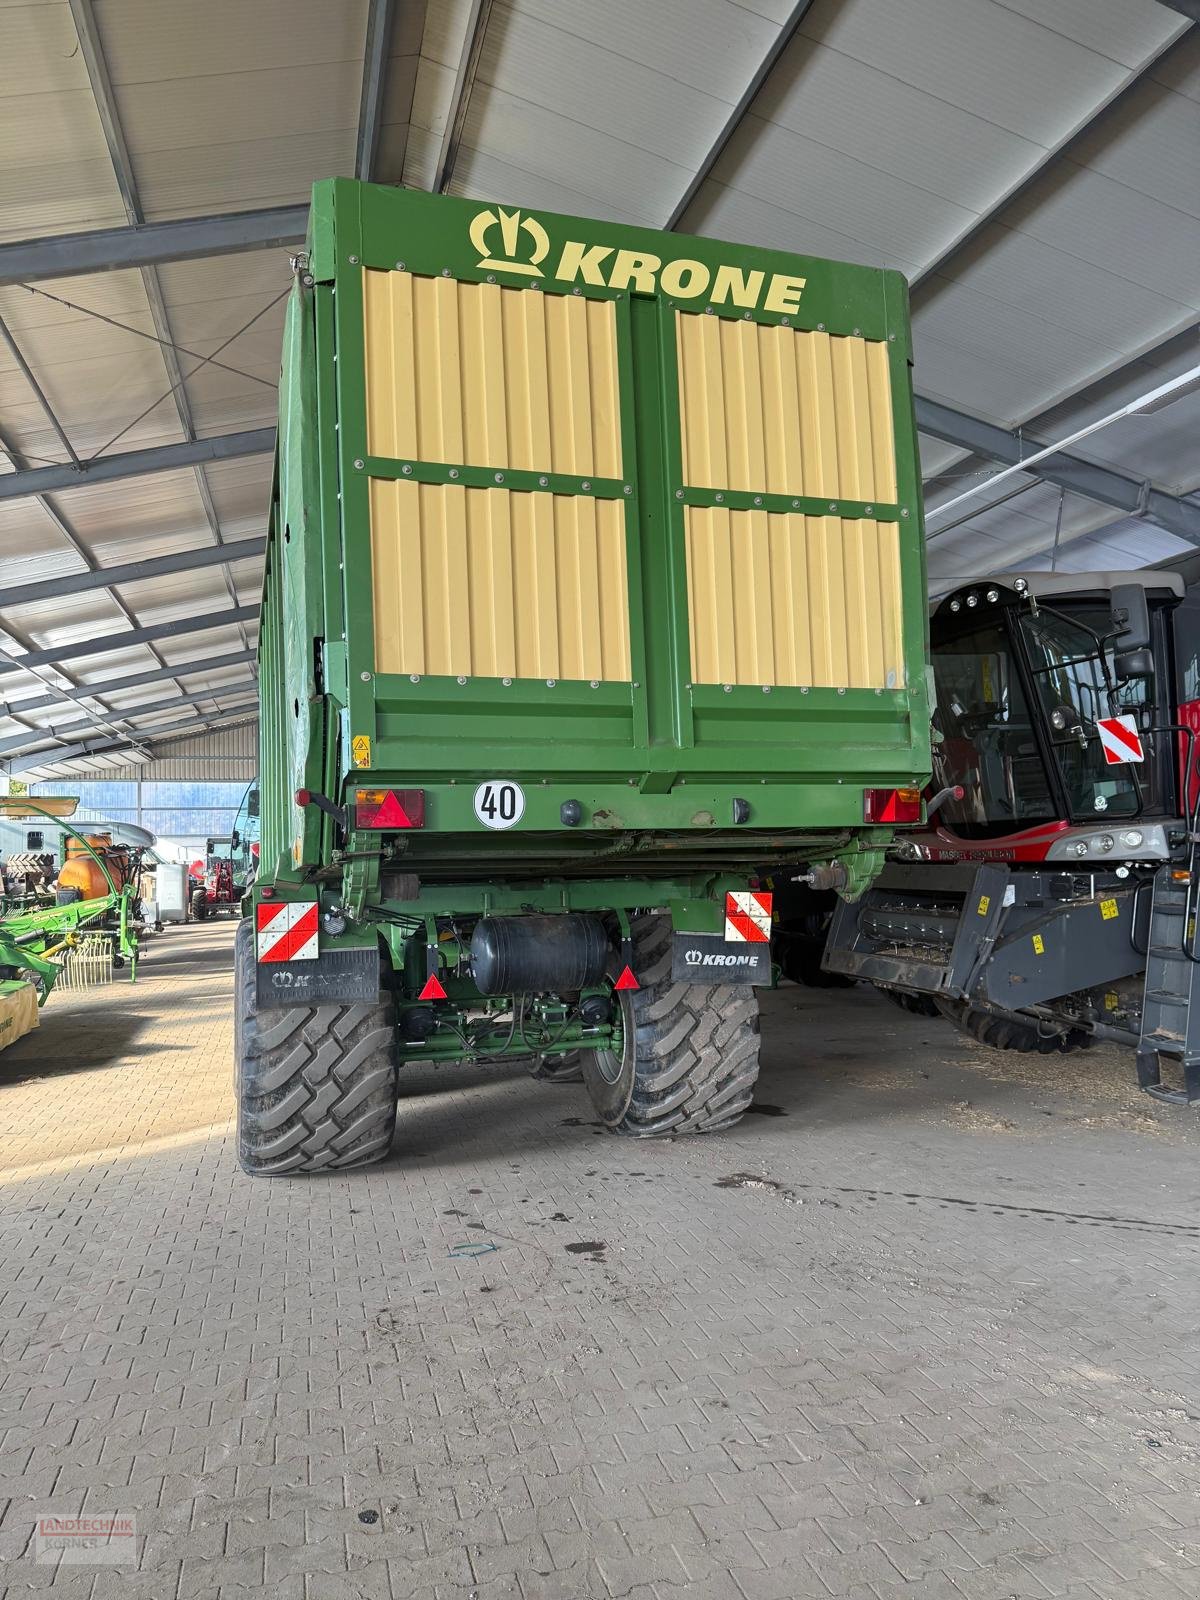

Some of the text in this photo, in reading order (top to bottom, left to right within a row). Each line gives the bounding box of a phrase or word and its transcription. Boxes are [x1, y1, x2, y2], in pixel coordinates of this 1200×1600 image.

[555, 240, 807, 315] KRONE
[481, 786, 516, 820] 40
[702, 954, 759, 967] KRONE
